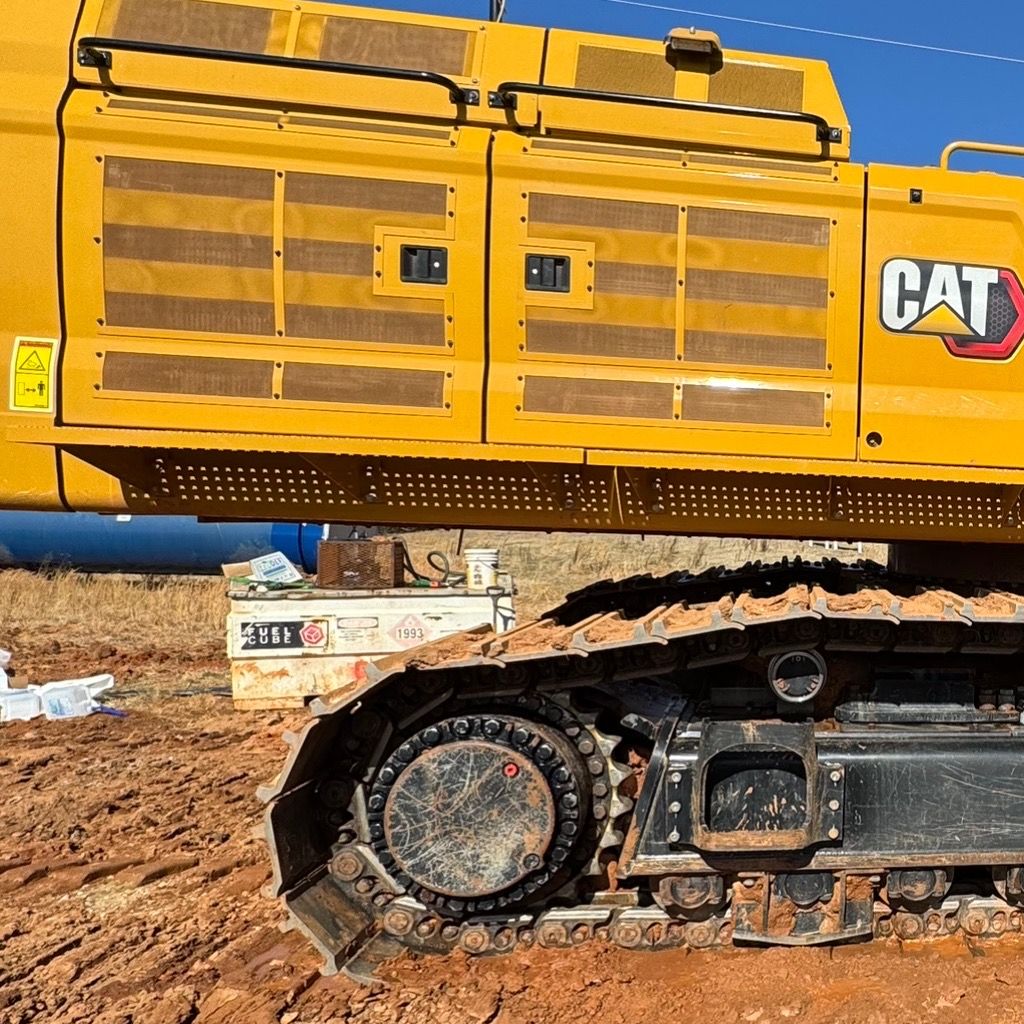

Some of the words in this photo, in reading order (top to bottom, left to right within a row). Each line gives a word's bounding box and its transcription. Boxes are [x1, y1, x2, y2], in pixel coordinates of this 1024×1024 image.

[882, 258, 998, 336] CAT
[247, 626, 291, 636] FUEL
[398, 628, 423, 639] 1993
[247, 636, 291, 645] CUBE
